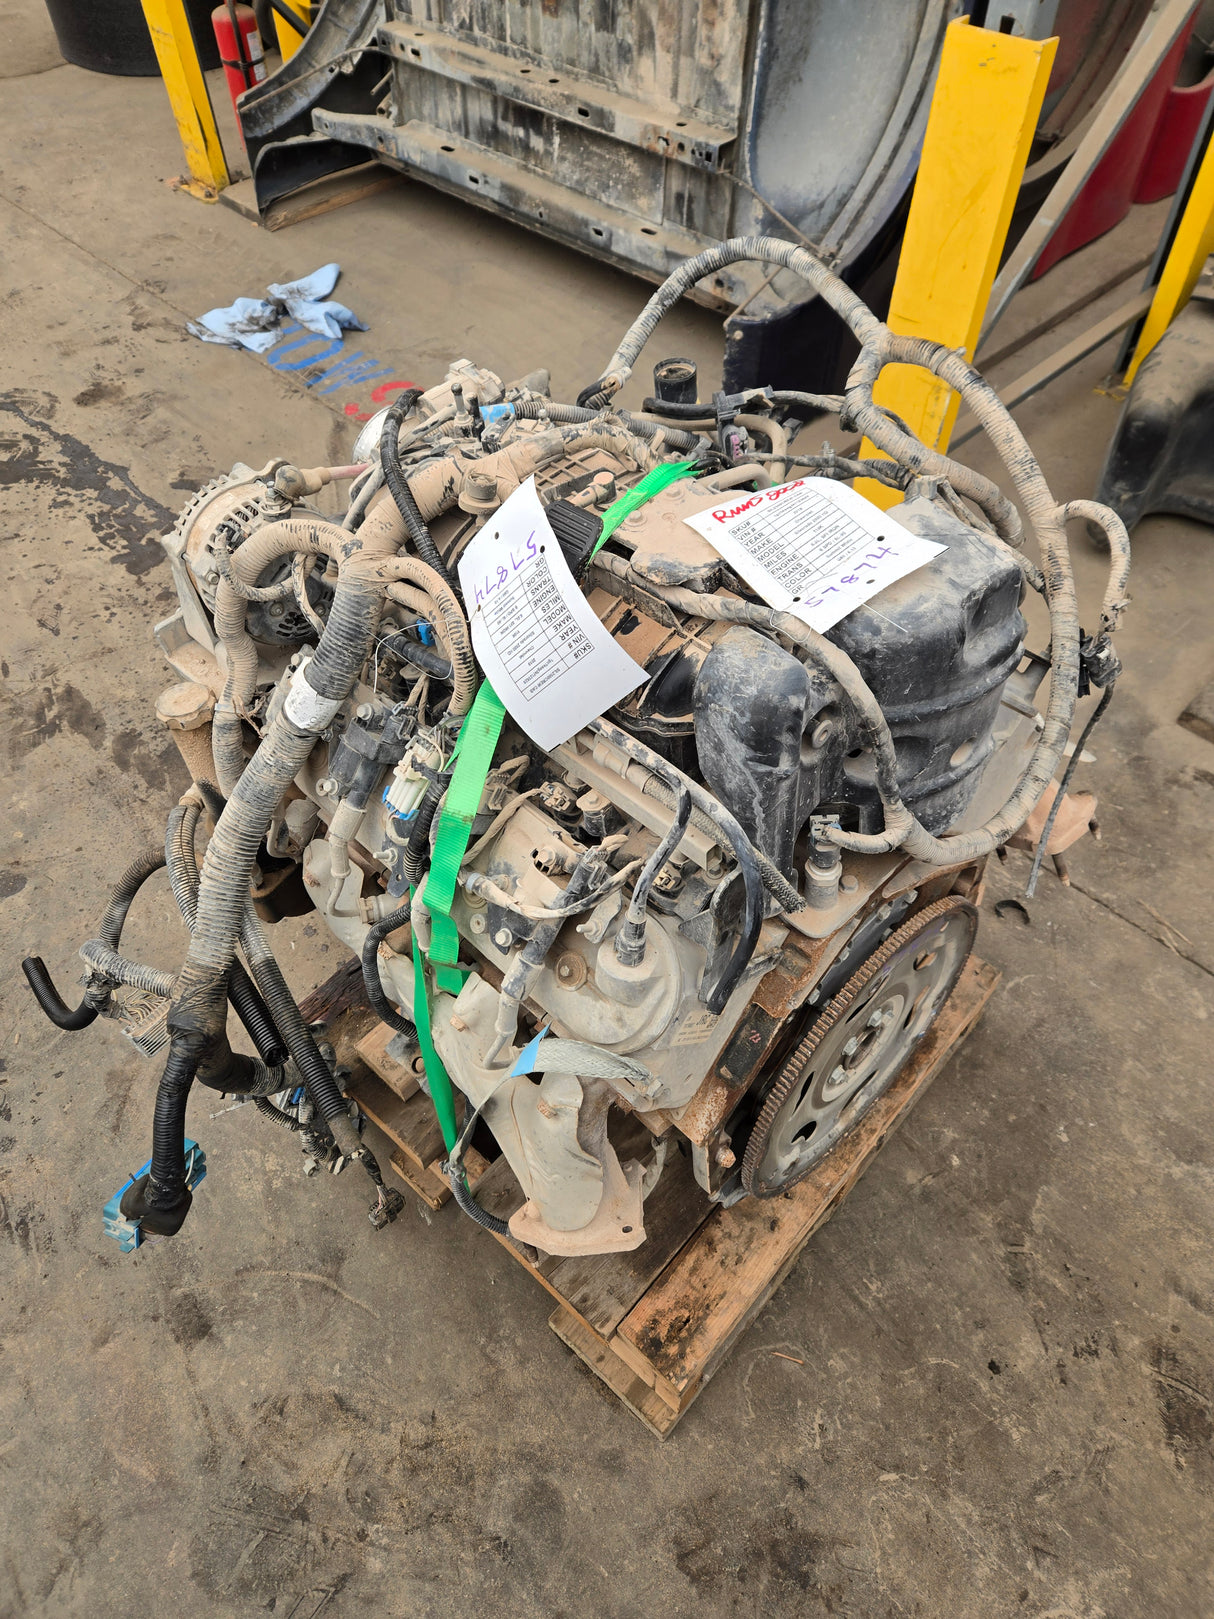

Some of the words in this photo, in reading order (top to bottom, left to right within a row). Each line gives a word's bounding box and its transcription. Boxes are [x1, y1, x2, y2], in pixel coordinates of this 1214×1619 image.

[766, 480, 805, 500] good
[729, 520, 752, 535] SKU#
[736, 530, 752, 541] VIN
[742, 531, 766, 548] YEAR
[748, 537, 774, 555] MAKE
[755, 541, 786, 562] MODEL
[762, 550, 788, 569] MILES
[474, 530, 537, 604] 57874
[534, 556, 545, 568] GR
[768, 553, 801, 576] ENGINE
[776, 561, 804, 582] TRANS
[525, 565, 548, 587] COLOR
[529, 575, 551, 596] TRANS
[783, 566, 812, 589] COLOR
[804, 546, 899, 608] 57874
[531, 583, 555, 608] ENGINE
[790, 583, 805, 595] GR
[540, 593, 560, 614] MILES
[542, 603, 566, 626] MODEL
[551, 613, 572, 633] MAKE
[558, 622, 578, 642] YEAR
[571, 631, 585, 646] VIN
[566, 641, 573, 650] #
[572, 640, 592, 660] SKU#
